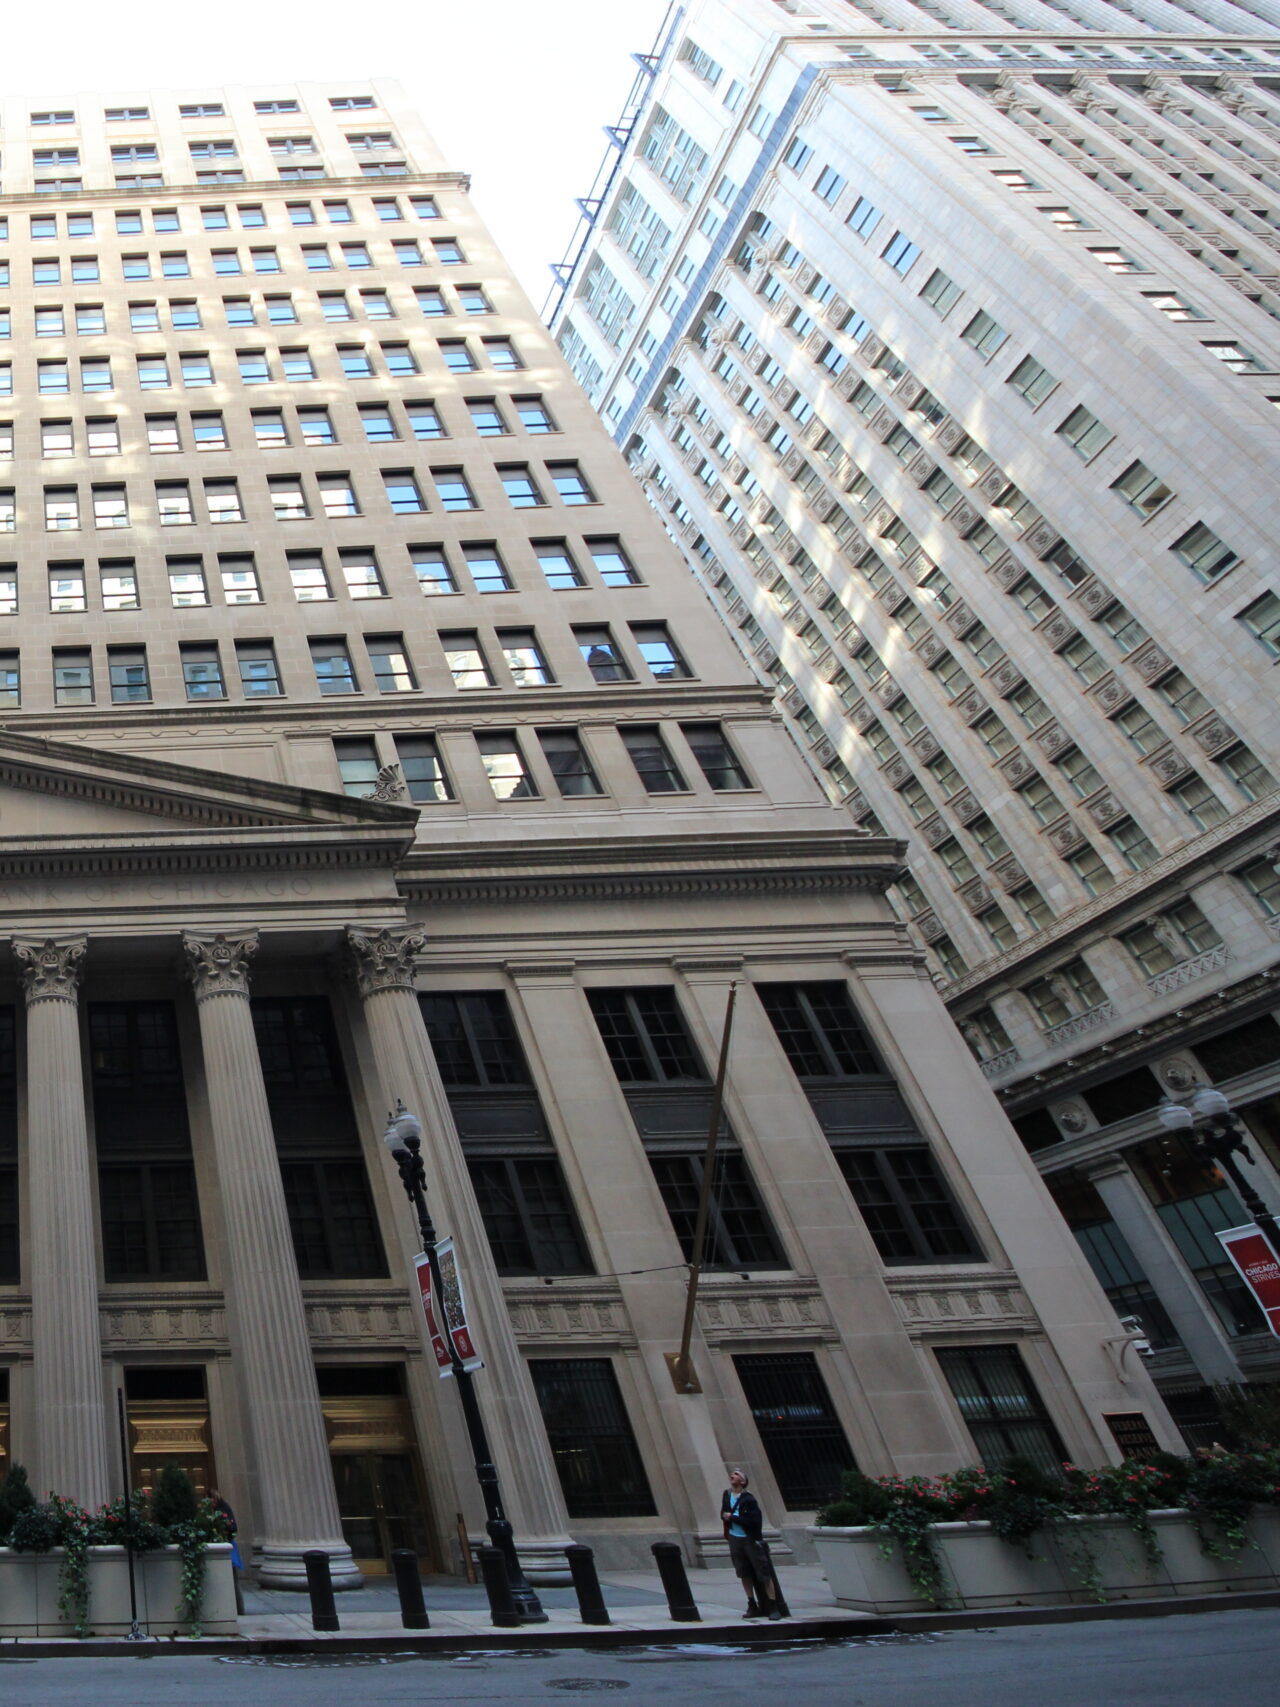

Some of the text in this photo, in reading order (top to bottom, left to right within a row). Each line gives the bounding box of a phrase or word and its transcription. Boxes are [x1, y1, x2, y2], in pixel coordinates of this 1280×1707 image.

[85, 881, 121, 902] OF
[147, 877, 313, 900] CHICAGO
[1245, 1262, 1278, 1276] CHICAGO
[1251, 1271, 1280, 1284] STRIVES
[1111, 1420, 1149, 1431] FEDERAL
[1117, 1433, 1154, 1444] RESERVE
